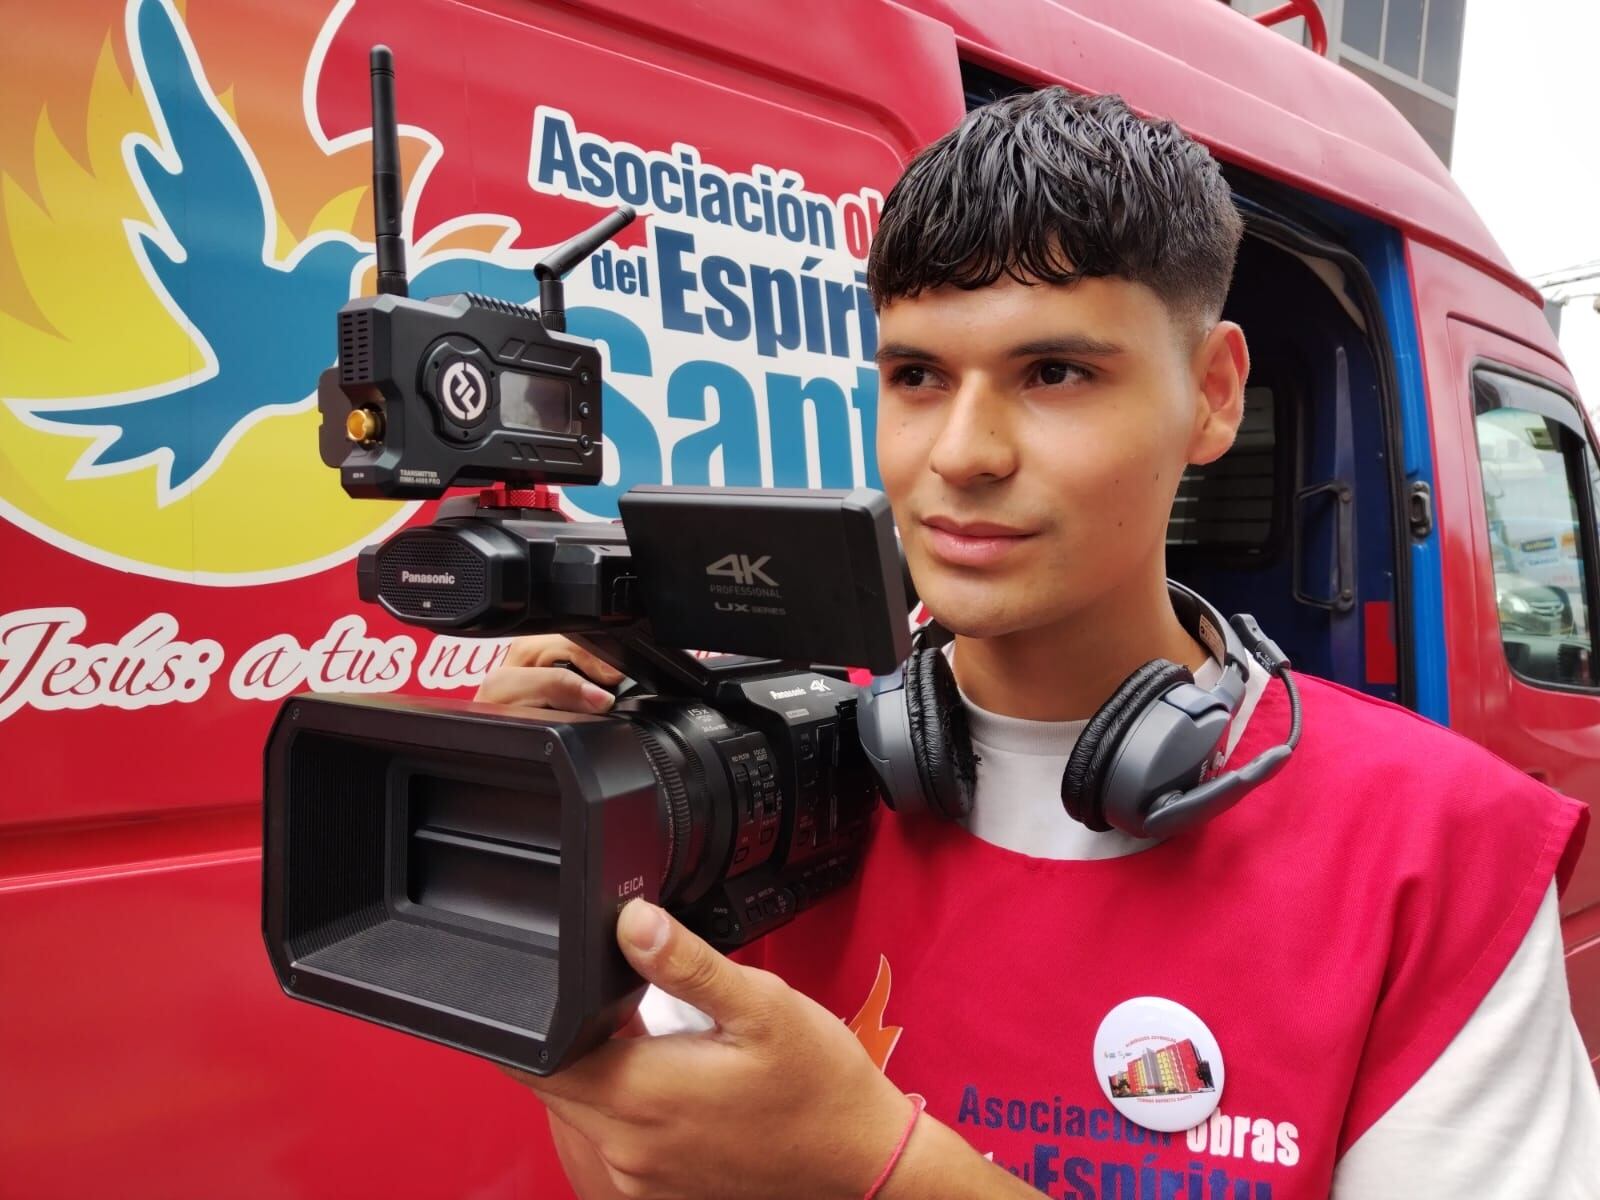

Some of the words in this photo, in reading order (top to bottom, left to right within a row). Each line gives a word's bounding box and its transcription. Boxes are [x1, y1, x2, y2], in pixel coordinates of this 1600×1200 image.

[538, 115, 835, 251] Asociación
[591, 249, 650, 297] del
[654, 226, 878, 363] Espíri
[560, 305, 881, 520] Sant
[401, 570, 456, 585] Panasonic
[706, 554, 780, 588] 4K
[709, 583, 783, 600] PROFESSIONAL
[713, 601, 750, 613] UX
[0, 620, 211, 704] Jesús:
[243, 643, 303, 688] a
[319, 629, 406, 687] tus
[769, 686, 808, 701] Panasonic
[809, 678, 834, 693] 4K
[618, 874, 645, 897] LEICA
[1186, 1106, 1300, 1167] obras
